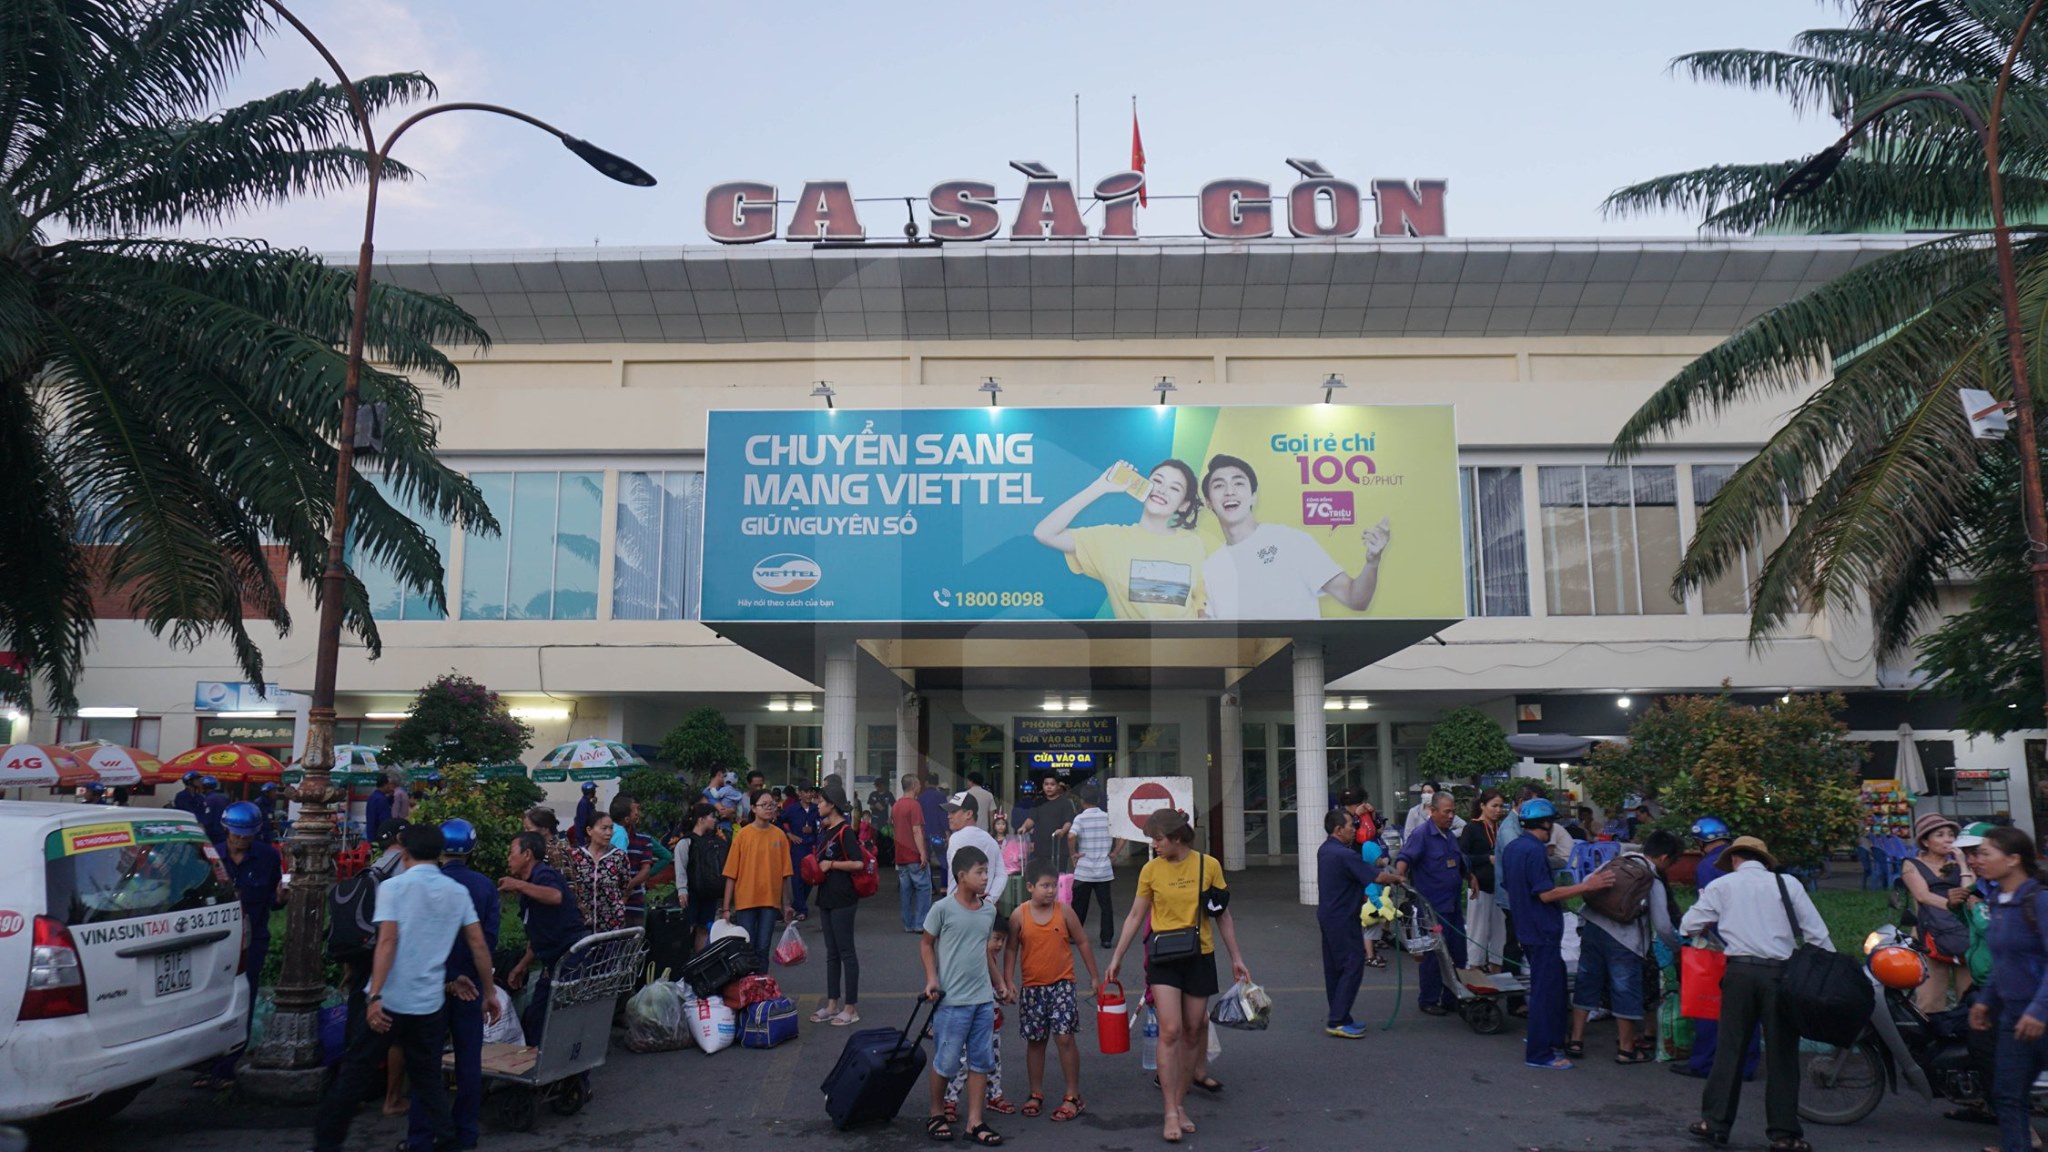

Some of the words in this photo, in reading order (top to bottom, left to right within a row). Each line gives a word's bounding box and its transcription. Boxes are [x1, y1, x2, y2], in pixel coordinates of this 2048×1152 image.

[704, 178, 866, 244] GA
[928, 160, 1145, 242] SÀI
[1198, 157, 1449, 239] GÒN
[745, 420, 908, 466] CHUYỂN
[915, 432, 1034, 465] SANG
[1270, 433, 1309, 455] Gọi
[1313, 432, 1338, 452] rẻ
[1341, 432, 1376, 452] chỉ
[1296, 454, 1377, 485] 100
[743, 473, 870, 511] MẠNG
[876, 472, 1045, 505] VIETTEL
[1306, 502, 1333, 518] 70
[741, 512, 782, 536] GIỮ
[784, 513, 880, 536] NGUYÊN
[883, 510, 918, 535] SỐ
[786, 599, 804, 607] cách
[805, 598, 818, 606] của
[819, 599, 834, 607] bạn
[955, 592, 998, 607] 1800
[1000, 592, 1044, 607] 8098
[1022, 719, 1062, 728] PHÒNG
[1065, 719, 1090, 728] BÁN
[1093, 718, 1109, 728] VÉ
[1020, 733, 1039, 743] CỬA
[1042, 734, 1061, 743] VÀO
[1064, 735, 1077, 743] GA
[1079, 735, 1089, 743] ĐI
[1092, 733, 1112, 743] TÀU
[6, 757, 42, 769] 4G
[1034, 752, 1054, 762] CỬA
[1055, 752, 1075, 762] VÀO
[1077, 754, 1091, 762] GA
[0, 915, 22, 932] 90
[190, 911, 219, 930] 38.27
[221, 909, 231, 923] 27
[232, 907, 240, 921] 27
